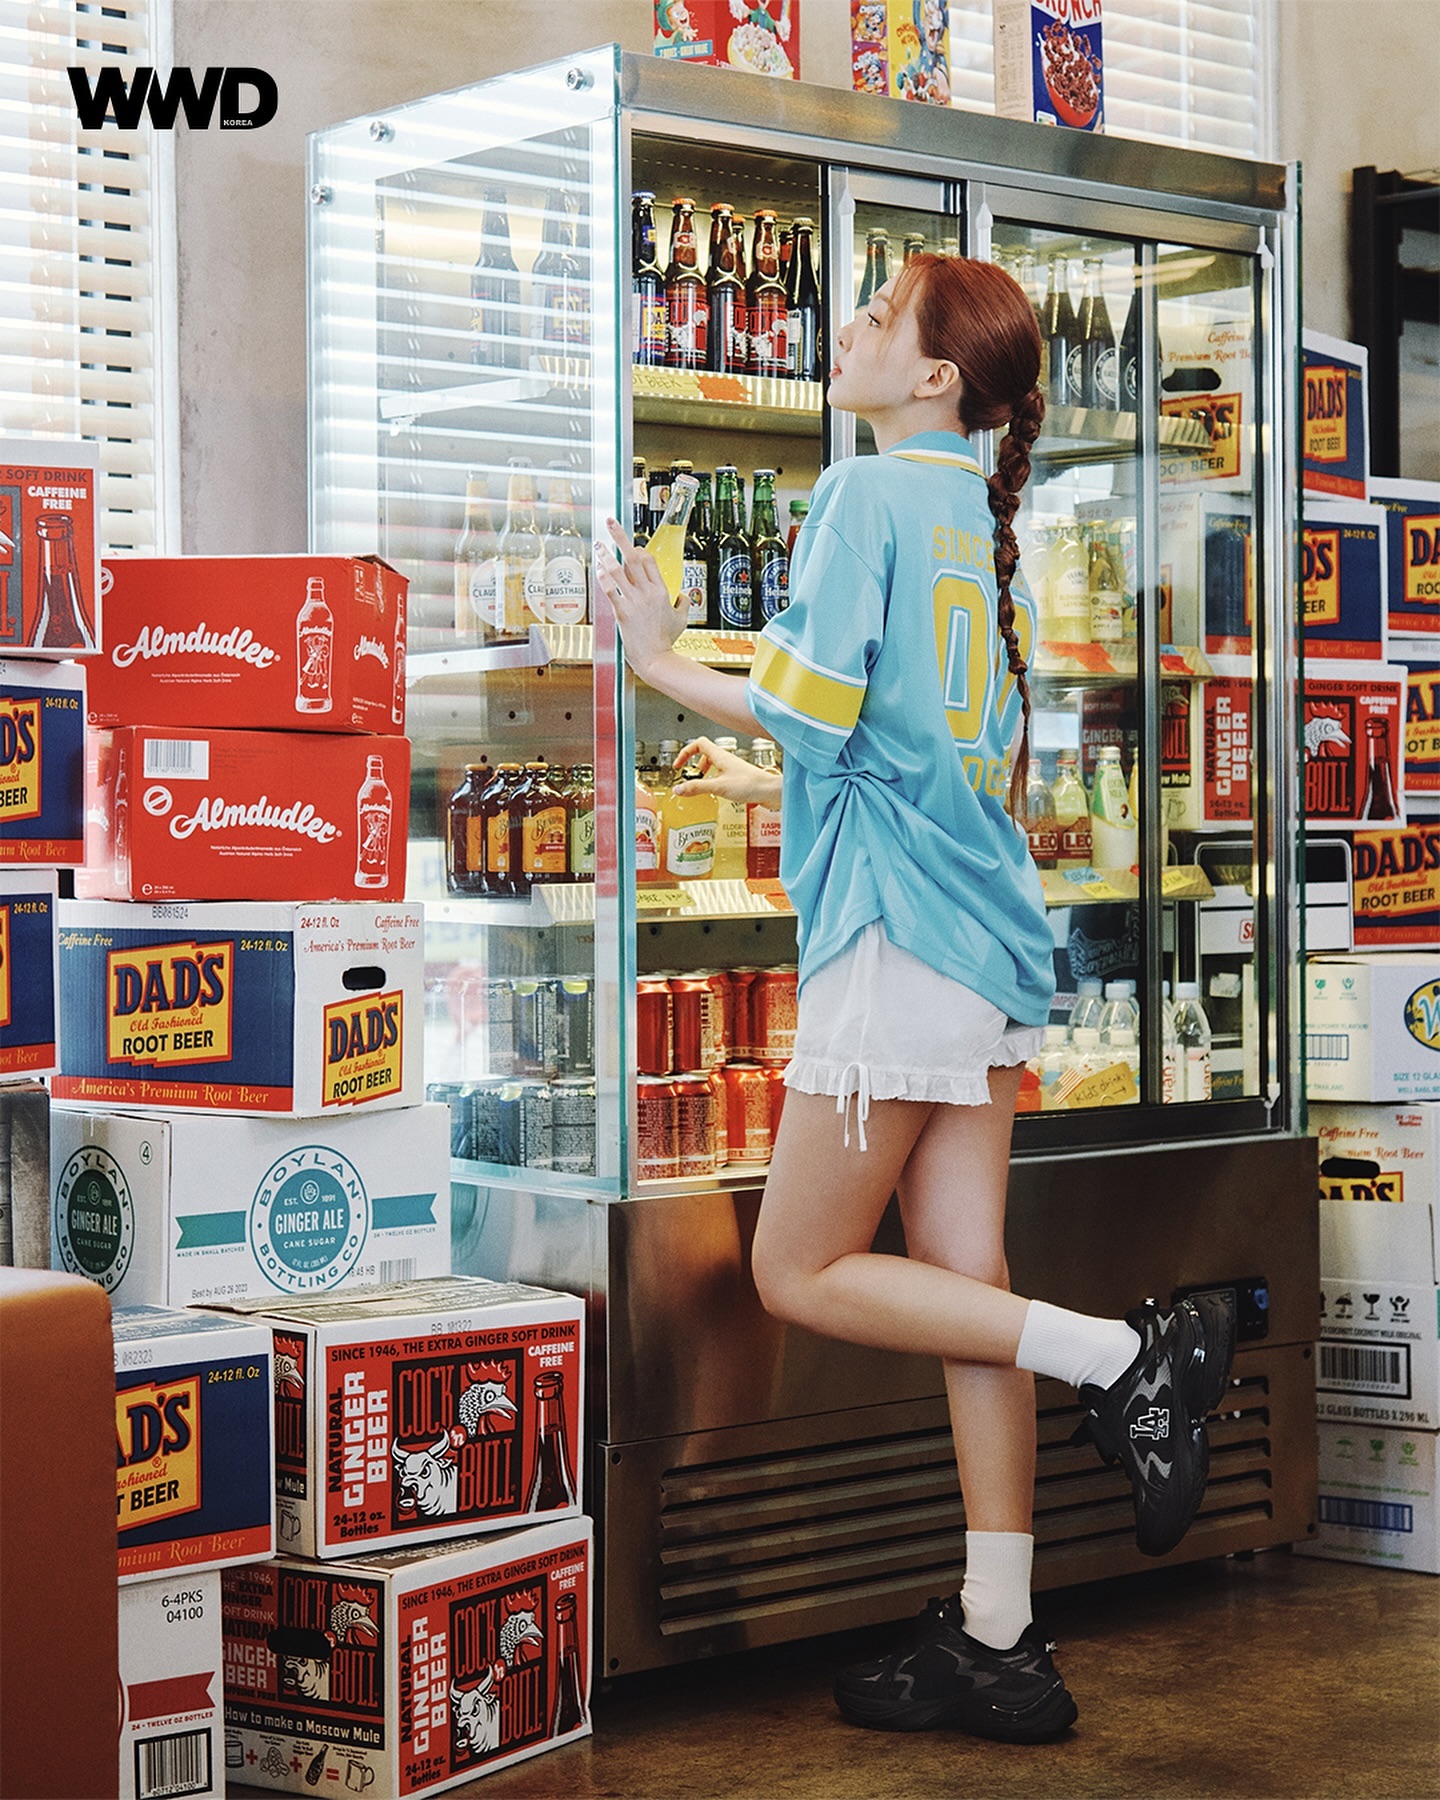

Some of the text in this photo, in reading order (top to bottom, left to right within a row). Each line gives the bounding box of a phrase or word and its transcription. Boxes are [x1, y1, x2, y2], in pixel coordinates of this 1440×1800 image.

[1036, 0, 1102, 21] UNCH
[1306, 375, 1344, 421] DAD'S
[6, 469, 87, 482] SOFT DRINK
[1191, 457, 1224, 471] BEER
[27, 486, 87, 499] CAFFEINE
[42, 498, 73, 510] FREE
[933, 525, 995, 574] SINCE
[112, 622, 274, 669] Almdudler
[1309, 683, 1397, 693] GINGER SOFT DRINK
[1359, 696, 1397, 705] CAFFEINE
[1369, 705, 1389, 714] FREE
[1082, 728, 1123, 744] GINGER
[1206, 706, 1215, 782] NATURAL
[1216, 696, 1231, 797] GINGER
[1232, 712, 1247, 781] BEER
[1305, 761, 1350, 812] BULL
[170, 795, 336, 844] Almdudler
[18, 840, 67, 861] Root Beer
[1029, 833, 1057, 849] LEO
[1065, 833, 1092, 849] LEO
[1361, 888, 1435, 909] ROOT BEER
[300, 917, 322, 929] 24-12
[330, 917, 340, 928] Oz
[374, 915, 403, 932] Caffeine
[404, 915, 419, 927] Free
[58, 932, 113, 949] Caffeine Free
[240, 939, 288, 952] 24-12 fl. Oz
[304, 937, 416, 953] America's Premium Root Beer
[114, 950, 224, 1017] DAD'S
[129, 1012, 203, 1032] Old Fashioned
[328, 1001, 399, 1065] DAD'S
[122, 1030, 214, 1055] ROOT BEER
[338, 1054, 386, 1078] Old Fashioned
[71, 1078, 269, 1106] America's Premium Root Beer
[333, 1067, 392, 1099] ROOT BEER
[1163, 1066, 1175, 1104] vian
[1319, 1126, 1379, 1142] Caffeine Free
[142, 1145, 149, 1161] 4
[1376, 1147, 1398, 1160] Root
[1401, 1148, 1425, 1159] Beer
[60, 1153, 128, 1208] BOYLAN
[260, 1153, 359, 1207] BOYLAN
[71, 1209, 118, 1236] GINGER ALE
[275, 1208, 345, 1235] GINGER ALE
[76, 1237, 112, 1249] CANE SUGAR
[283, 1236, 336, 1249] CANE SUGAR
[259, 1234, 359, 1289] BOTTLING CO
[331, 1324, 576, 1362] SINCE 1946, THE EXTRA GINGER SOFT DRINK
[527, 1341, 575, 1357] CAFFEINE
[539, 1356, 563, 1368] FREE
[208, 1366, 260, 1384] 24-12 fl. Oz
[399, 1365, 455, 1438] COCK
[329, 1387, 343, 1493] NATURAL
[343, 1371, 365, 1507] GINGER
[366, 1389, 389, 1485] BEER
[284, 1477, 305, 1495] Mule
[460, 1438, 515, 1511] BULL
[130, 1479, 180, 1512] BEER
[333, 1511, 386, 1527] 24-12 oz.
[340, 1523, 379, 1538] Bottles
[402, 1545, 586, 1610] SINCE 1946, THE EXTRA GINGER SOFT DRINK
[550, 1561, 585, 1581] CAFFEINE
[559, 1576, 576, 1591] FREE
[161, 1588, 203, 1609] 6-4PKS
[283, 1576, 328, 1631] COCK
[166, 1605, 204, 1623] 04100
[454, 1598, 497, 1679] COCK
[225, 1664, 268, 1689] BEER
[331, 1649, 379, 1708] BULL
[412, 1616, 430, 1756] GINGER
[430, 1631, 448, 1729] BEER
[401, 1634, 412, 1744] NATURAL
[500, 1665, 543, 1746] BULL
[131, 1724, 142, 1732] 24
[147, 1718, 173, 1728] TWELVE
[184, 1711, 213, 1722] BOTTLES
[225, 1706, 249, 1722] How
[250, 1712, 261, 1724] to
[264, 1714, 293, 1731] make
[295, 1722, 302, 1732] a
[305, 1720, 350, 1739] Moscow
[353, 1727, 380, 1744] Mule
[405, 1756, 446, 1777] 24-12 oz.
[411, 1769, 441, 1788] Bottles
